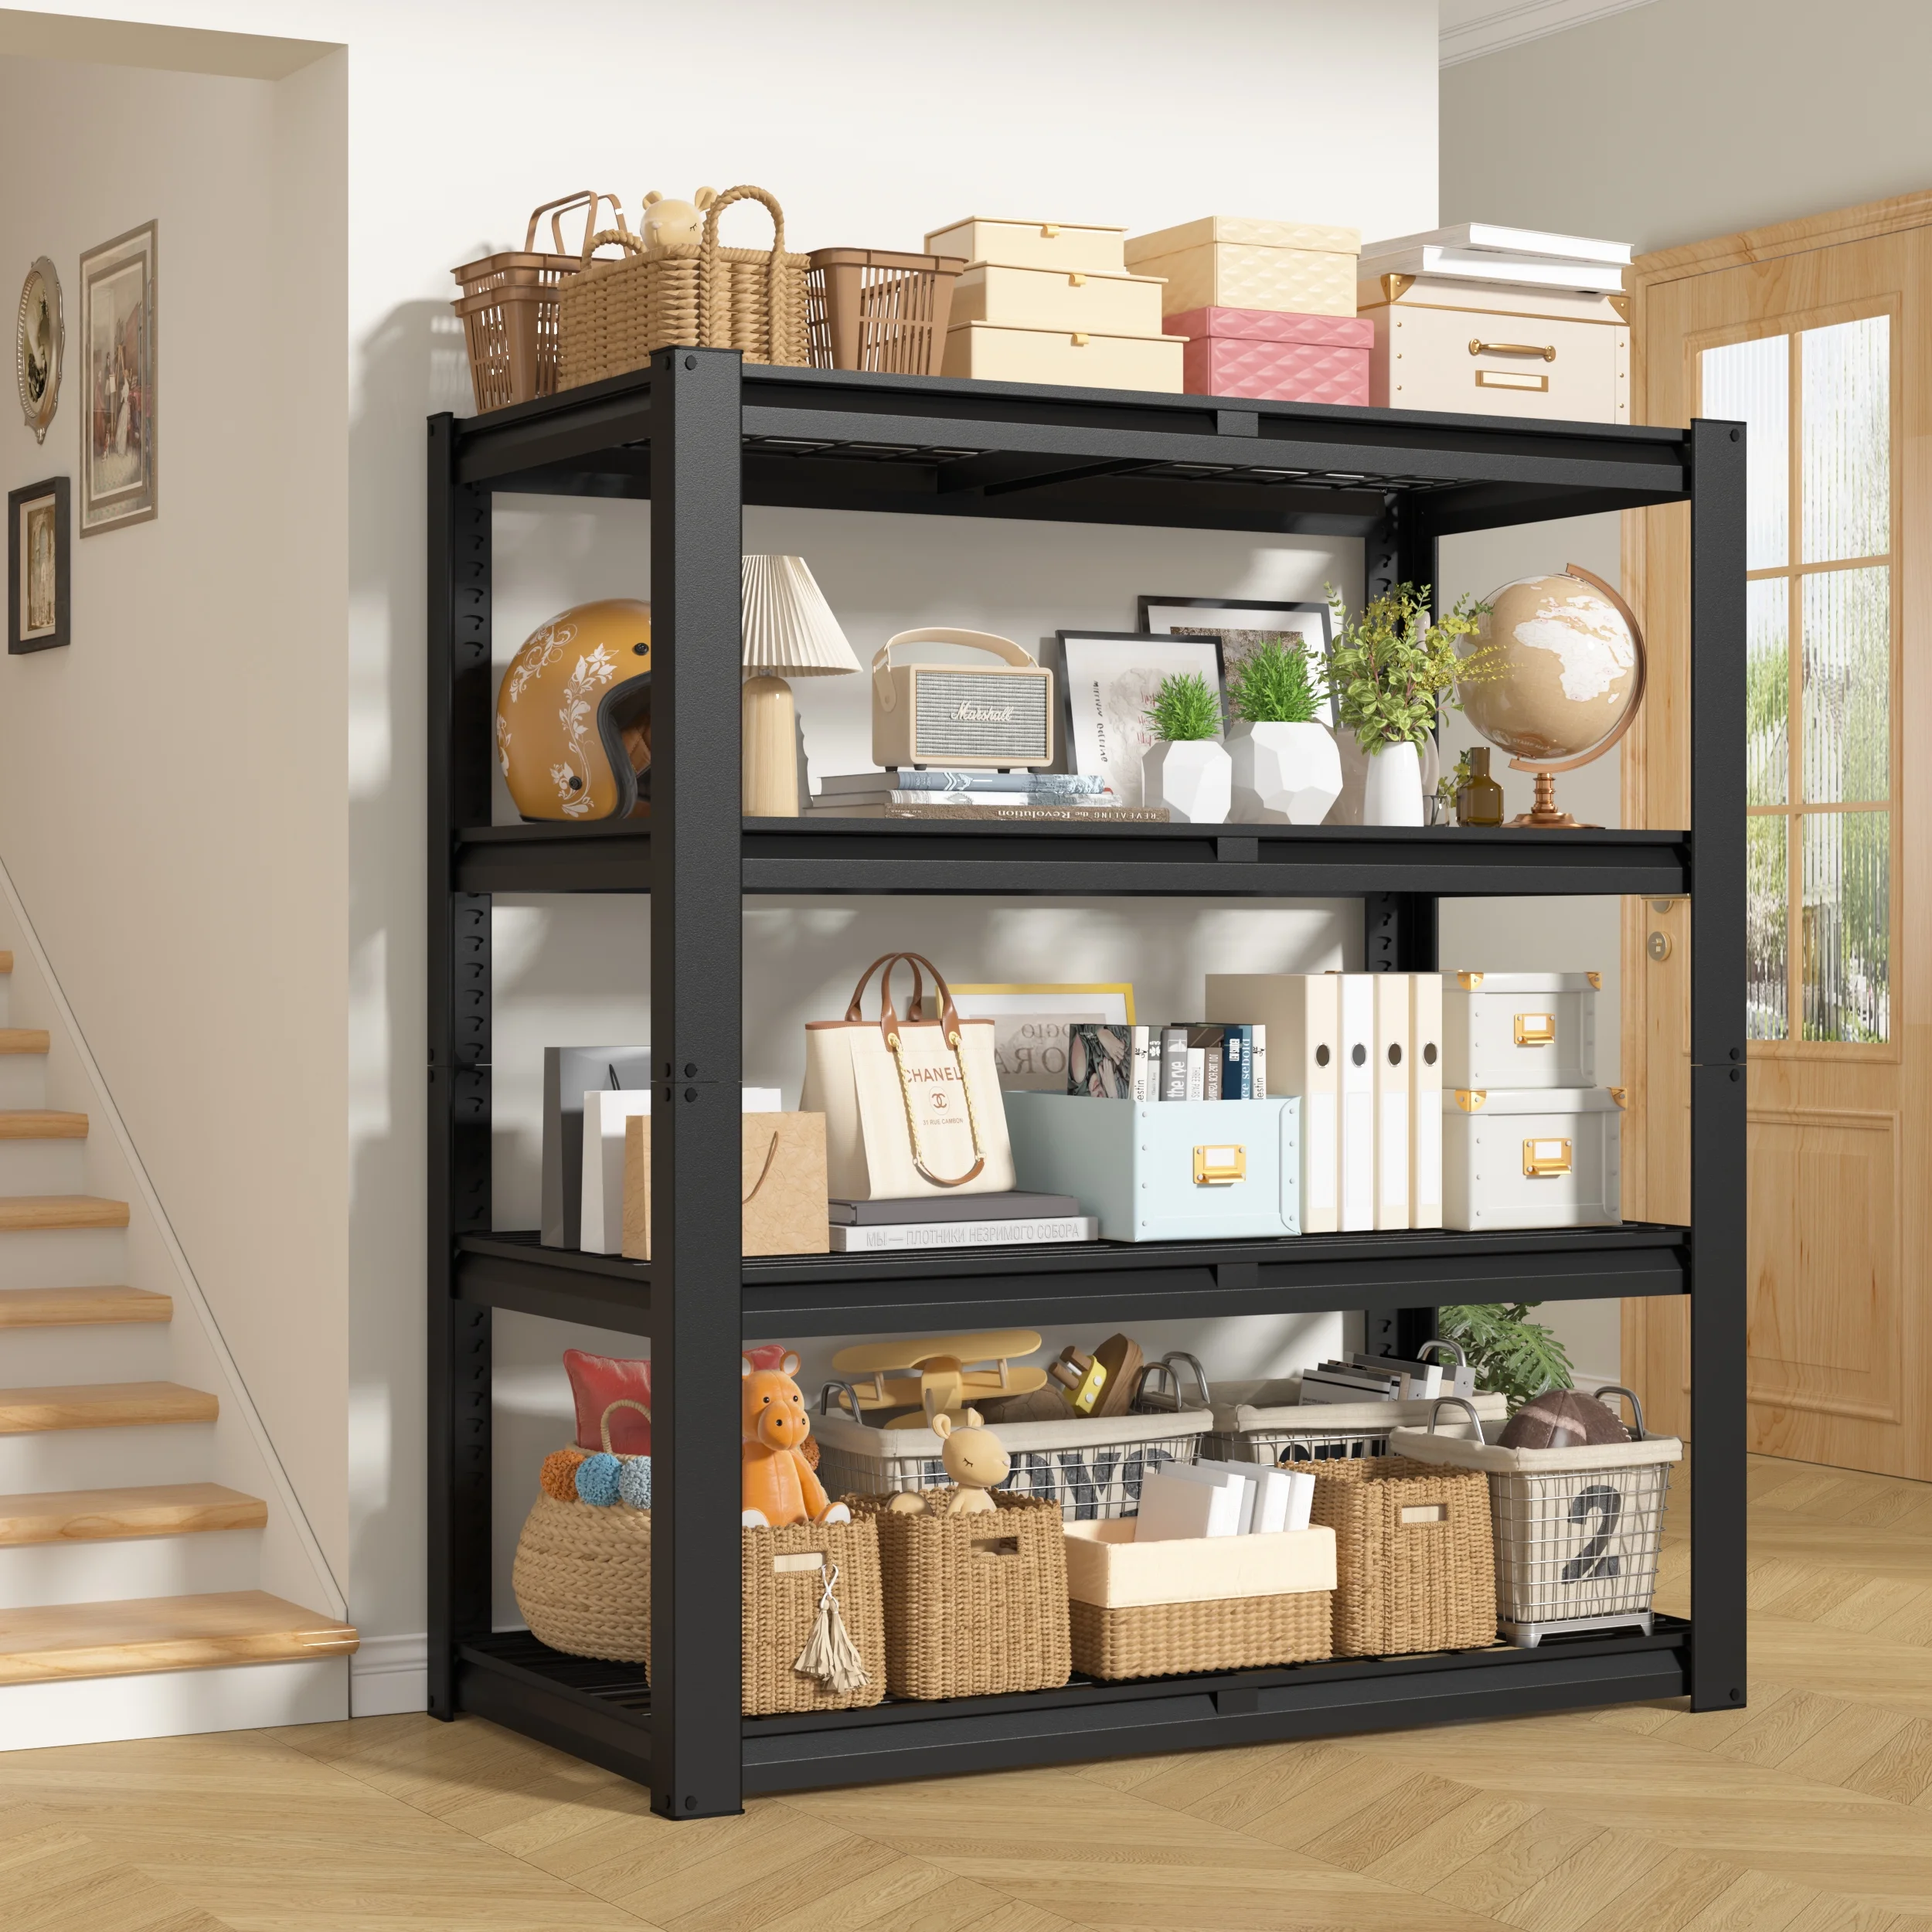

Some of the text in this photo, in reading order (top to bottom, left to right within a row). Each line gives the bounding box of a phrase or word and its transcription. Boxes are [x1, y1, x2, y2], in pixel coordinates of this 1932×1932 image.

[951, 701, 1014, 722] Marshall
[998, 809, 1071, 819] Revolution
[1094, 810, 1157, 820] REVEALING
[1242, 1039, 1250, 1079] sebold
[1165, 1061, 1187, 1097] the rye
[1191, 1066, 1201, 1083] THREE
[1134, 1080, 1145, 1102] estin
[1191, 1083, 1200, 1098] PAIRS
[866, 1231, 887, 1247] МЫ
[906, 1227, 965, 1245] ПЛОТНИКИ
[969, 1226, 1034, 1243] НЕЗРИМОГО
[1037, 1223, 1080, 1240] СОБОРА
[1561, 1485, 1621, 1585] 2
